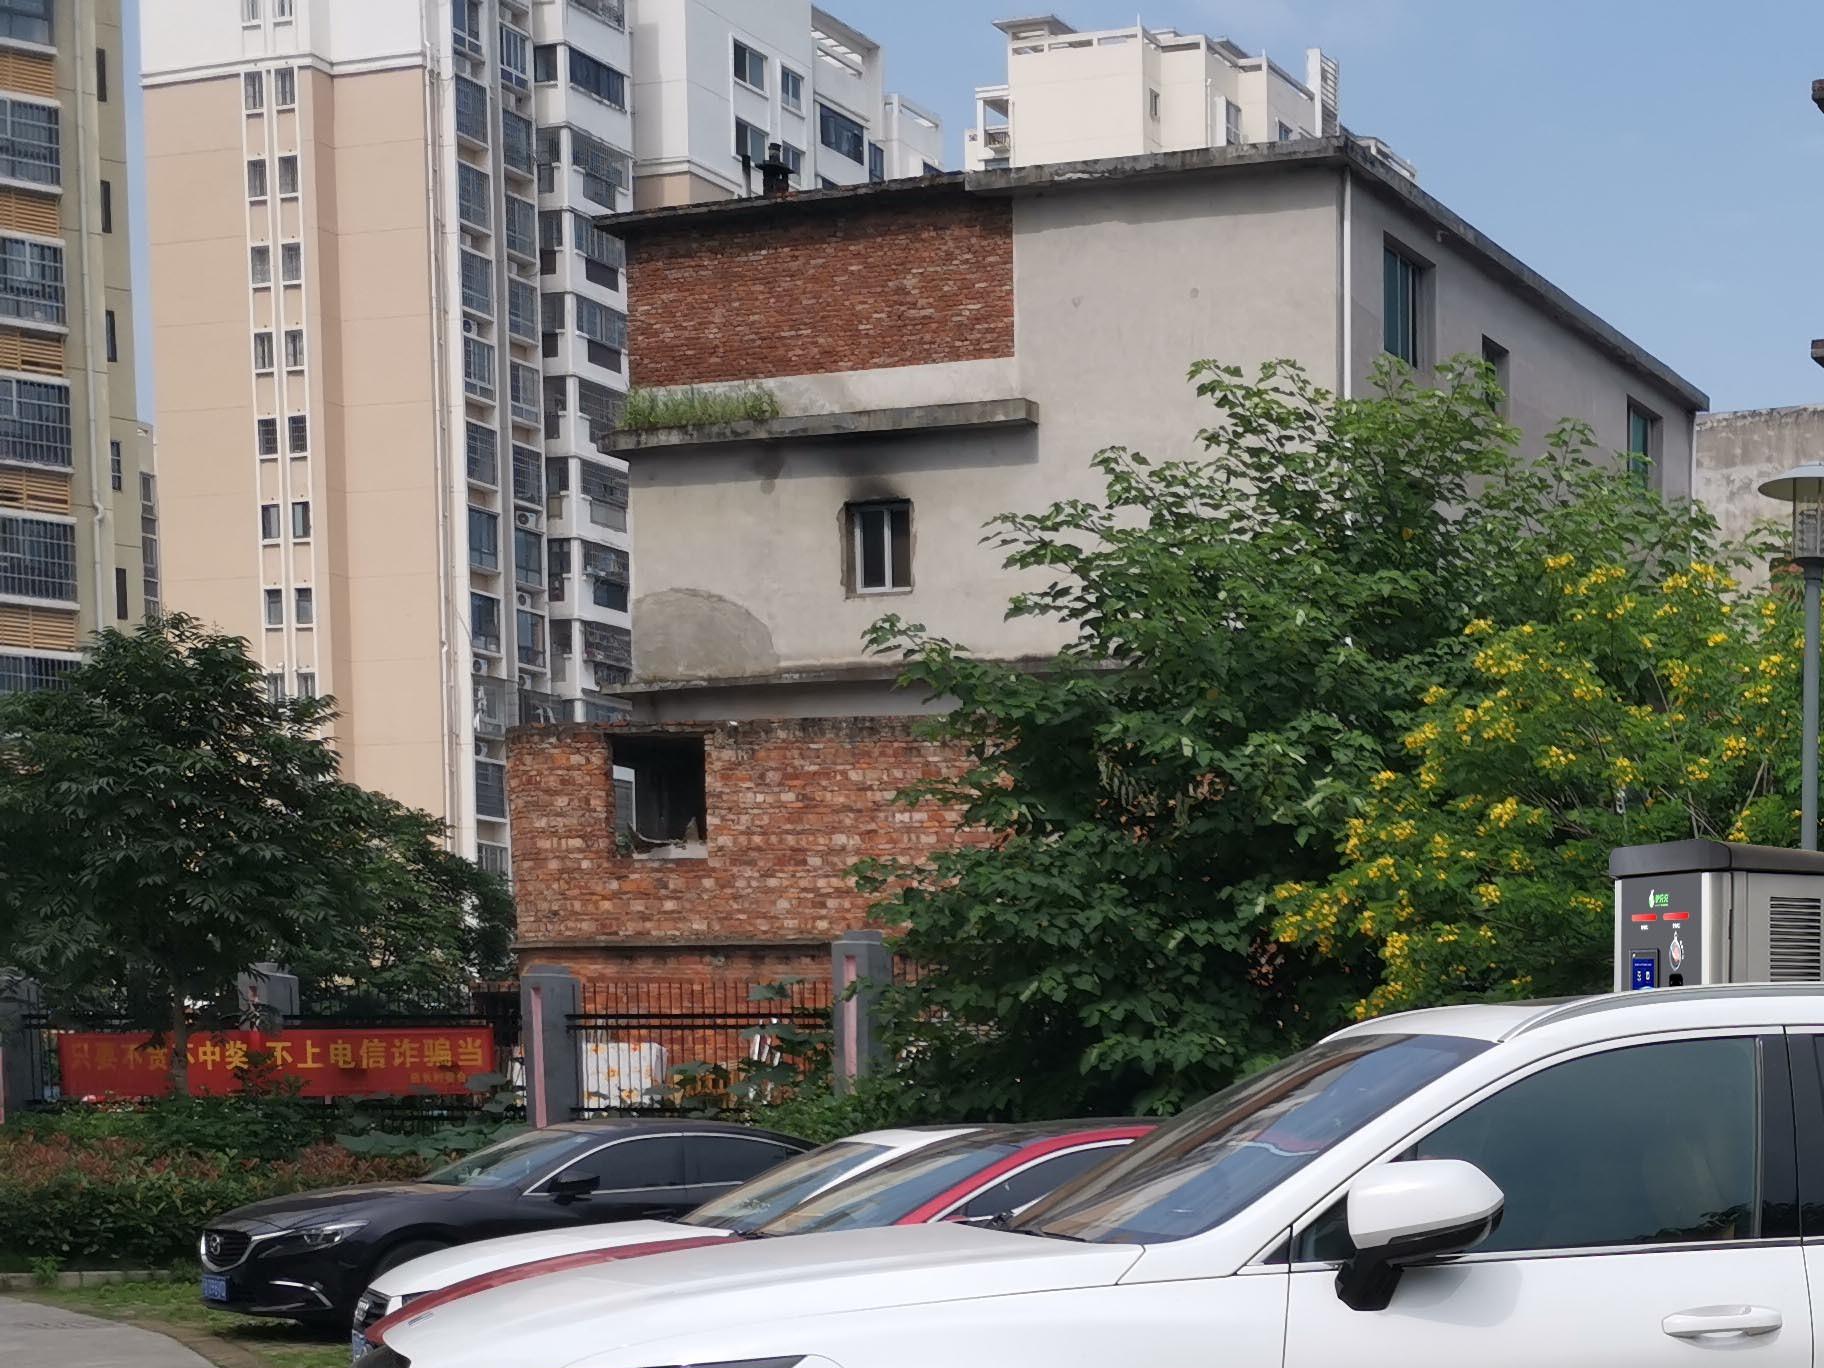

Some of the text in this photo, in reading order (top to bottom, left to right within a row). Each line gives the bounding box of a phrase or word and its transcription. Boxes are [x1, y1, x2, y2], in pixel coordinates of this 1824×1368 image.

[265, 1037, 484, 1070] 不上电信诈骗当
